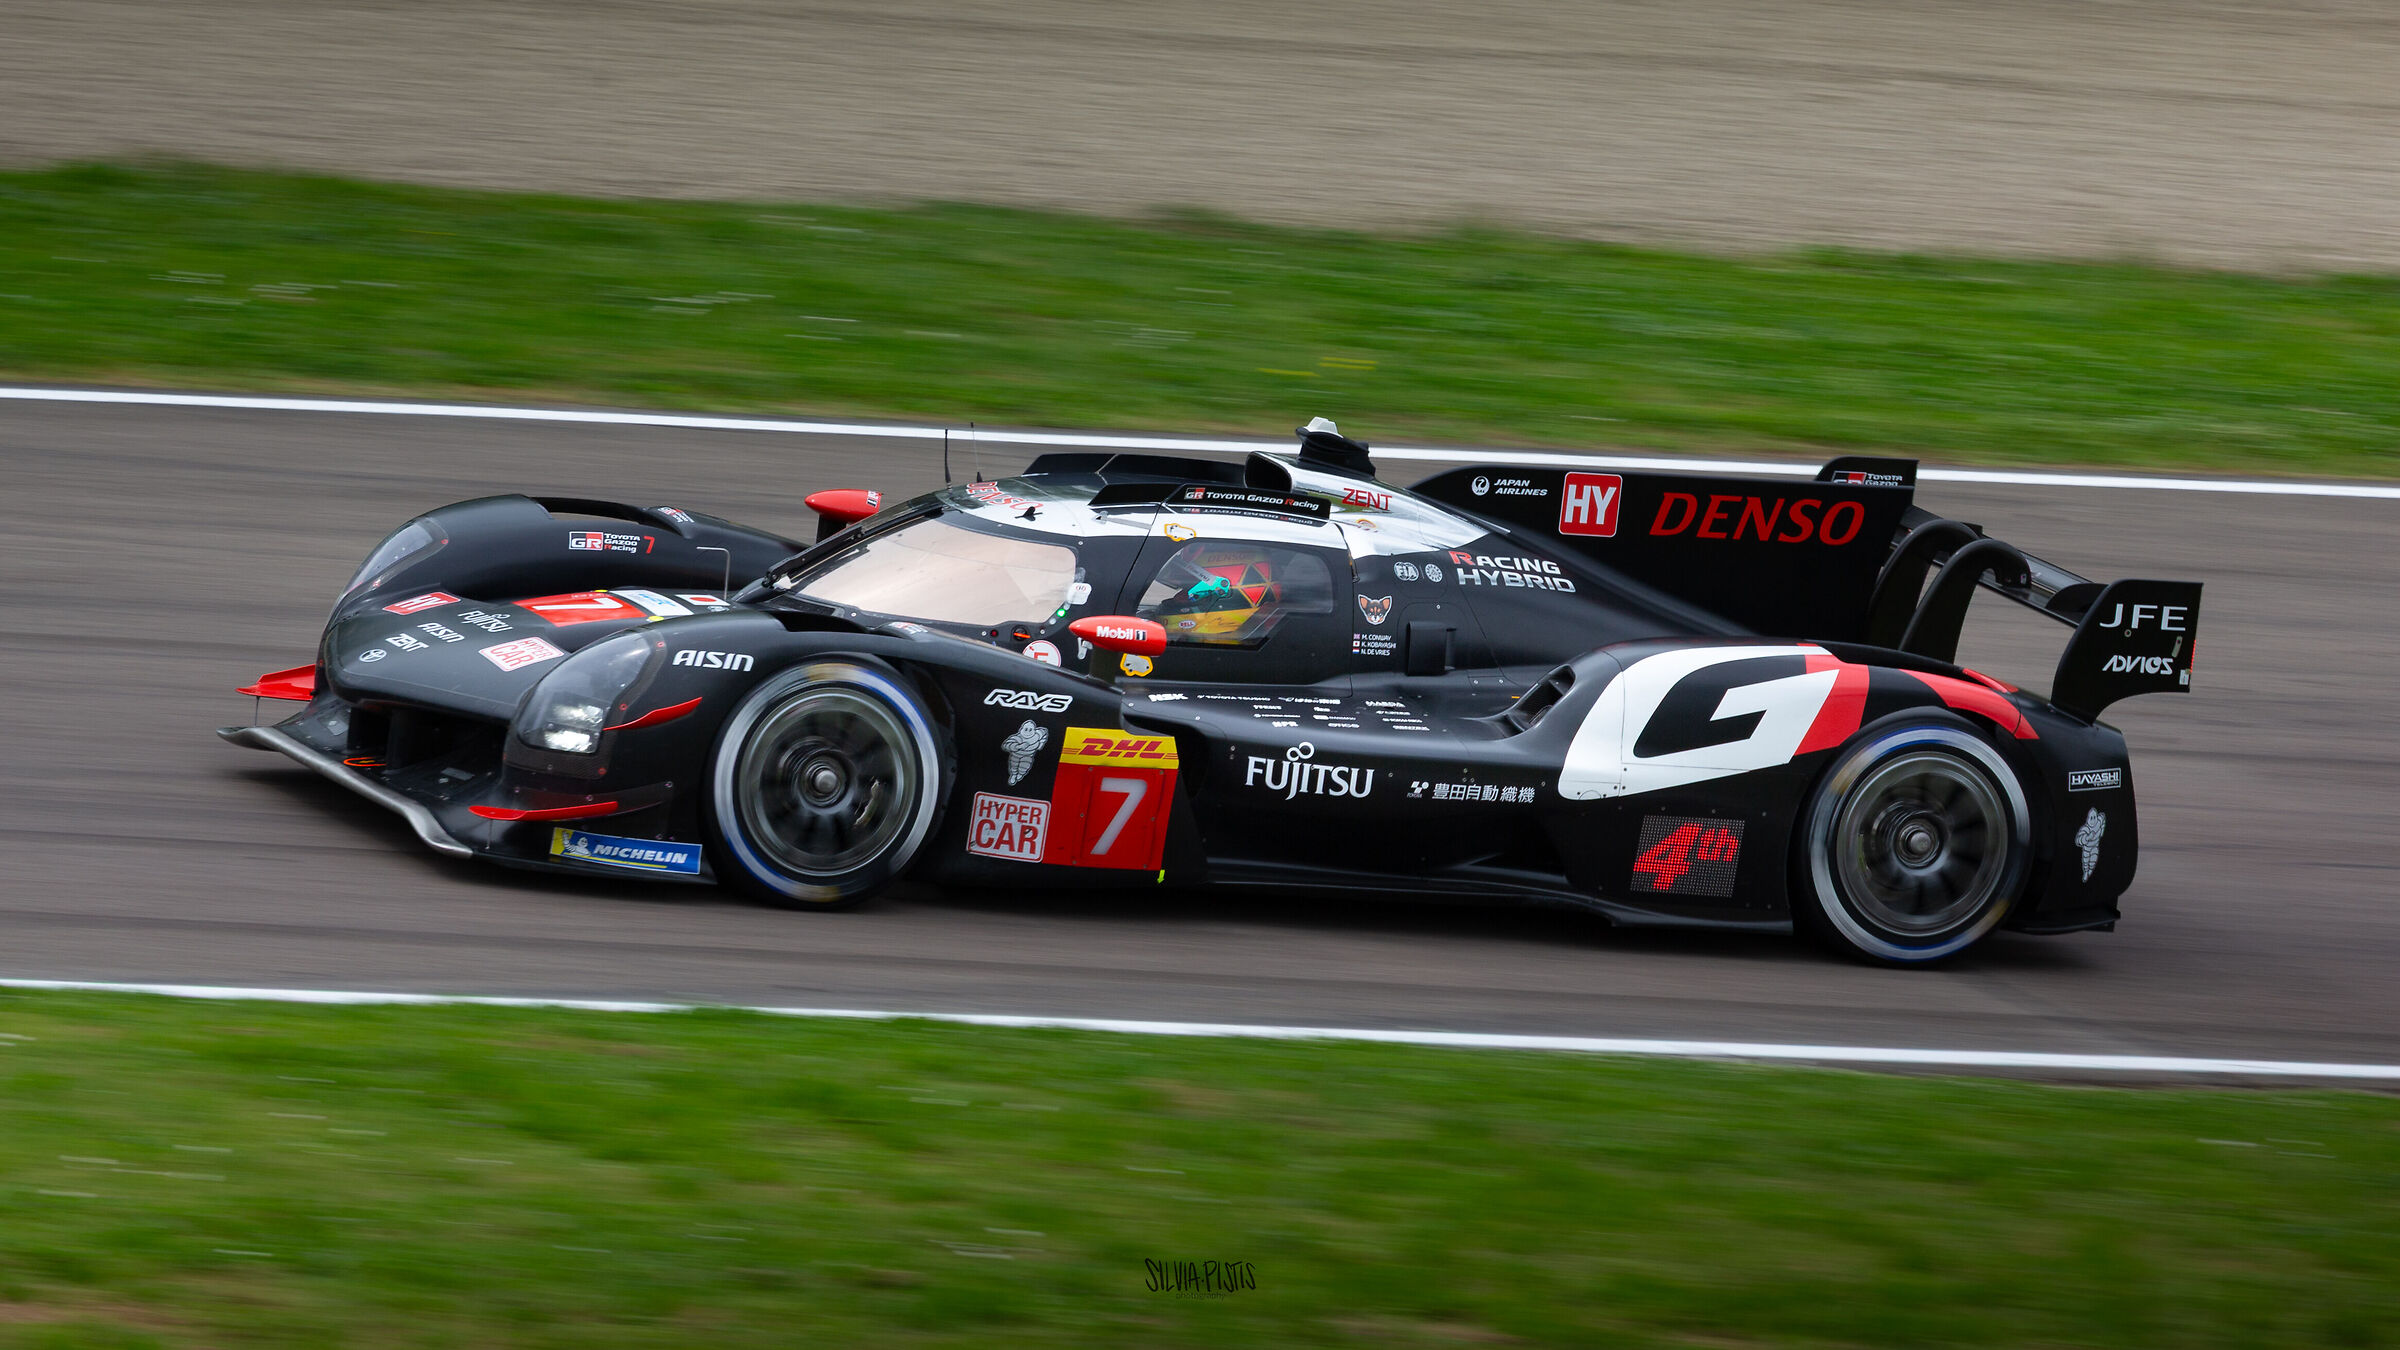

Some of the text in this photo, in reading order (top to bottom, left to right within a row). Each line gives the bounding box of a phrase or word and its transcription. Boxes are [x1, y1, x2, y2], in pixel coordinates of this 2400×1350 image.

[1494, 478, 1530, 487] JAPAN
[1867, 473, 1903, 481] TOYOTA
[965, 481, 1044, 511] DENSO
[1185, 490, 1319, 511] GR TOYOTA GAZOO Racing
[1342, 487, 1393, 511] ZENT
[1495, 487, 1548, 496] AIRLINES
[1564, 484, 1617, 525] HY
[1649, 492, 1865, 546] DENSO
[570, 537, 602, 549] GR
[604, 533, 641, 541] TOYOTA
[643, 535, 656, 554] 7
[604, 544, 637, 553] Racing
[1396, 564, 1418, 578] FIA
[1448, 551, 1561, 575] RACING
[1456, 568, 1576, 593] HYBRID
[394, 594, 451, 610] HY
[532, 597, 623, 610] 7
[457, 610, 513, 633] FUJITSU
[2100, 603, 2188, 631] JFE
[385, 633, 429, 652] ZENT
[417, 622, 465, 643] AISIN
[1096, 625, 1147, 641] Mobil 1
[490, 644, 534, 667] CAR
[519, 639, 553, 659] HYPER
[1367, 641, 1396, 649] KOBAYASHI
[672, 649, 754, 672] AISIN
[2102, 655, 2174, 675] ADVICS
[985, 689, 1072, 712] RAYS
[1078, 737, 1166, 759] DHL
[1244, 754, 1375, 800] FUJITSU
[2071, 771, 2119, 785] HAYASHI
[978, 799, 1043, 825] HYPER
[1090, 776, 1148, 855] 7
[975, 818, 1039, 855] CAR
[593, 843, 688, 864] MICHELIN
[1633, 822, 1740, 891] 4th
